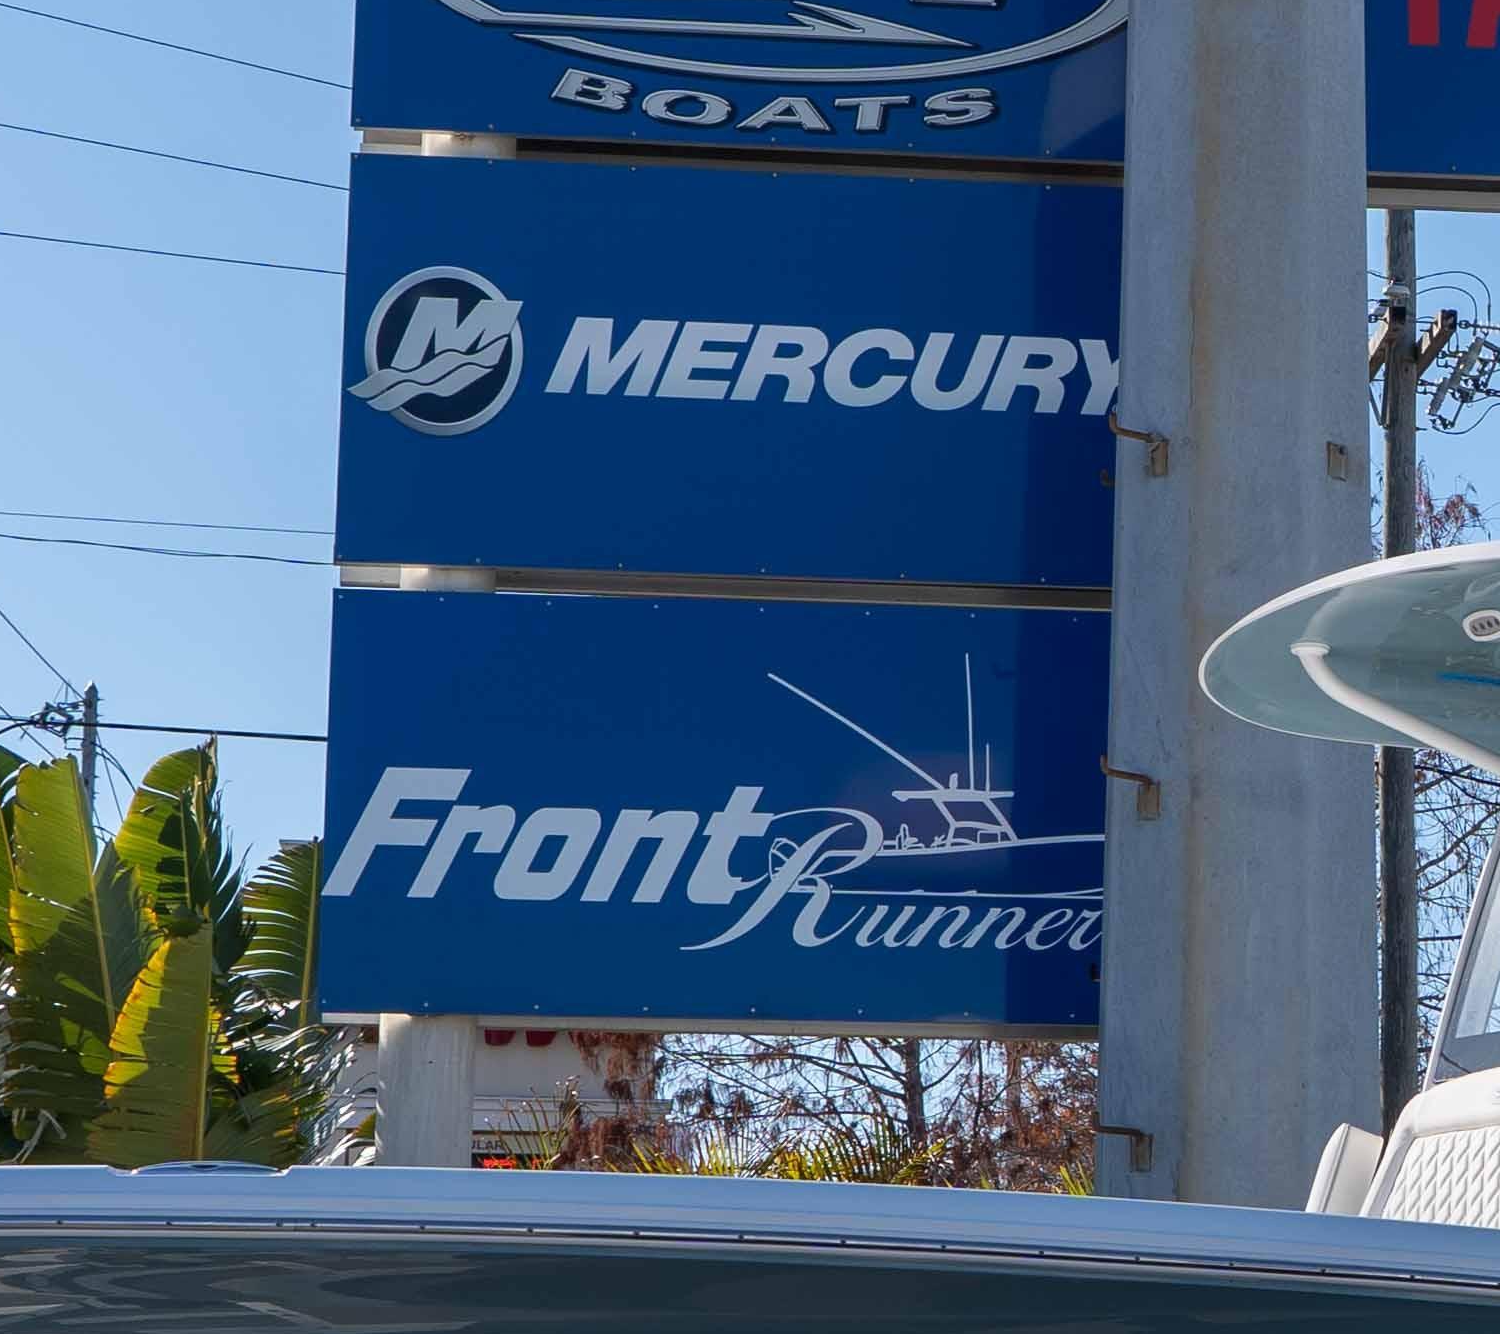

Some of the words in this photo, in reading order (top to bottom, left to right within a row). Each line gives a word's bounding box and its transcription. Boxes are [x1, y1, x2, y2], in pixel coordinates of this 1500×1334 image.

[551, 68, 997, 131] BOATS
[543, 316, 1122, 416] MERCURY
[321, 766, 775, 904] Front
[679, 807, 1104, 952] Runner
